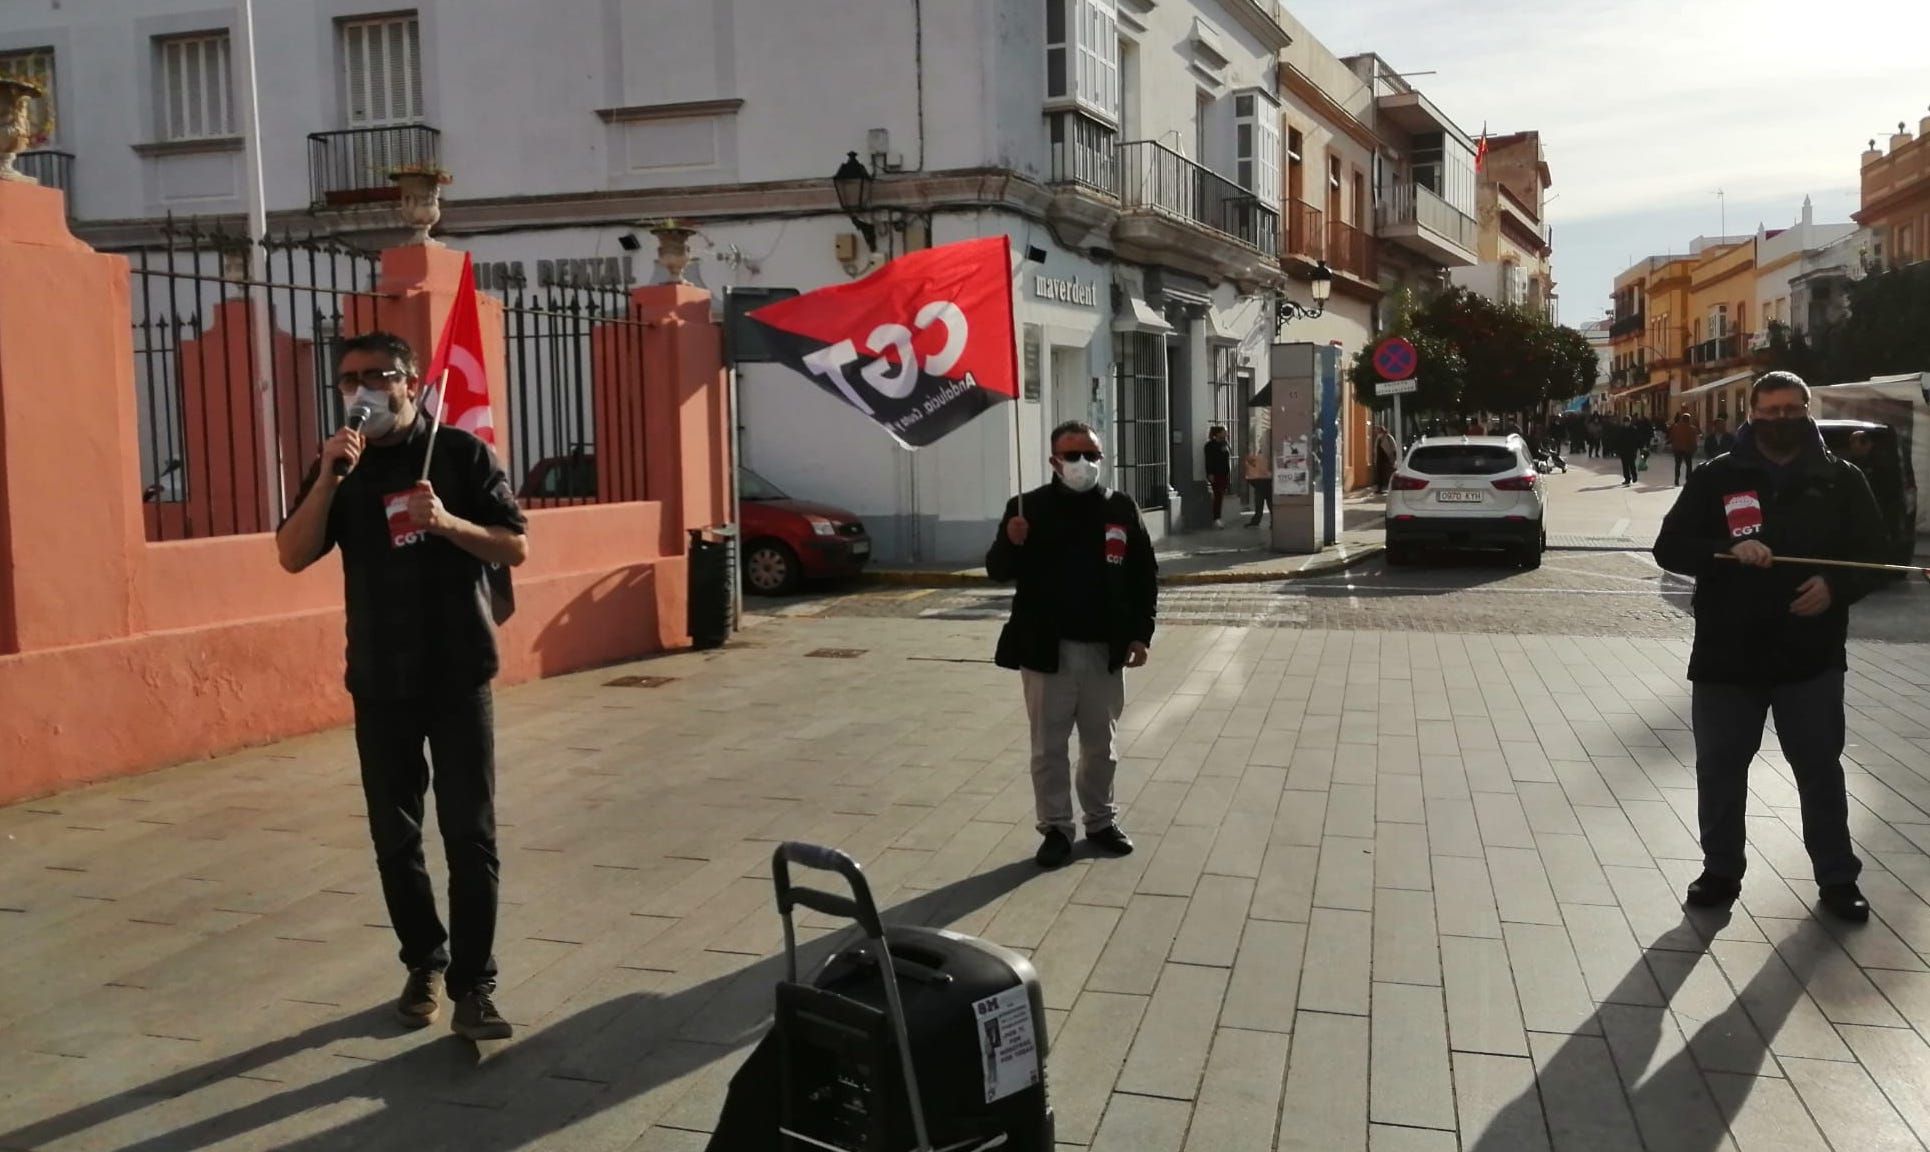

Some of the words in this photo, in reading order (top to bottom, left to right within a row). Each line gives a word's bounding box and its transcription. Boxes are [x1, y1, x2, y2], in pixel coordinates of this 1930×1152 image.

[536, 256, 636, 288] DENTAL
[1036, 275, 1096, 306] maverdent
[394, 529, 426, 547] CGT
[1733, 524, 1761, 536] CGT
[1106, 553, 1124, 567] CGT
